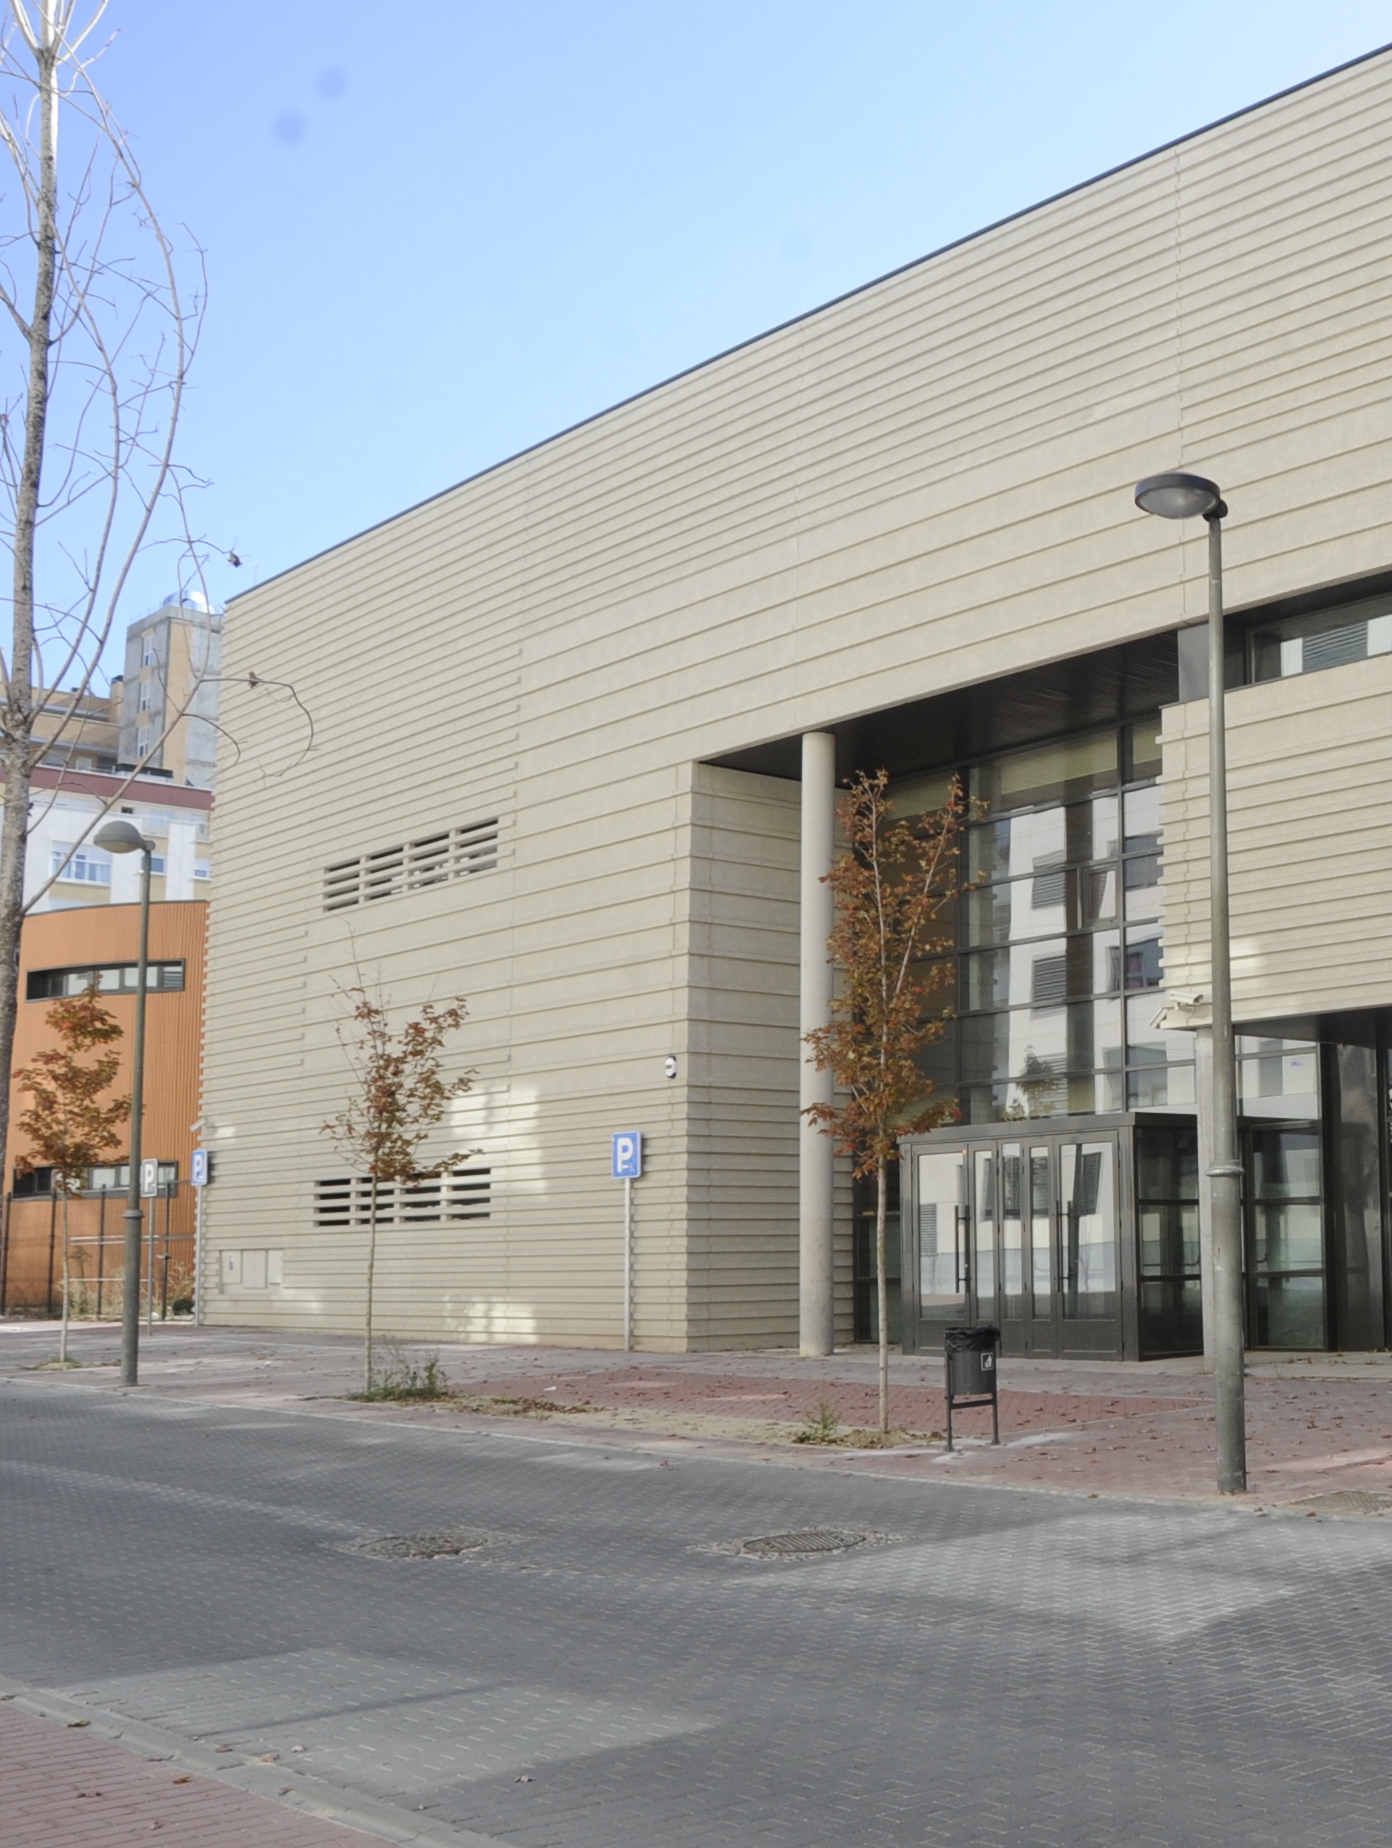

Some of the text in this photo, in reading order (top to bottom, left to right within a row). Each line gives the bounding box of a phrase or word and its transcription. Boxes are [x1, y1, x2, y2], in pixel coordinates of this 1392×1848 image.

[194, 1154, 204, 1181] P
[617, 1137, 634, 1173] P
[144, 1164, 155, 1193] P
